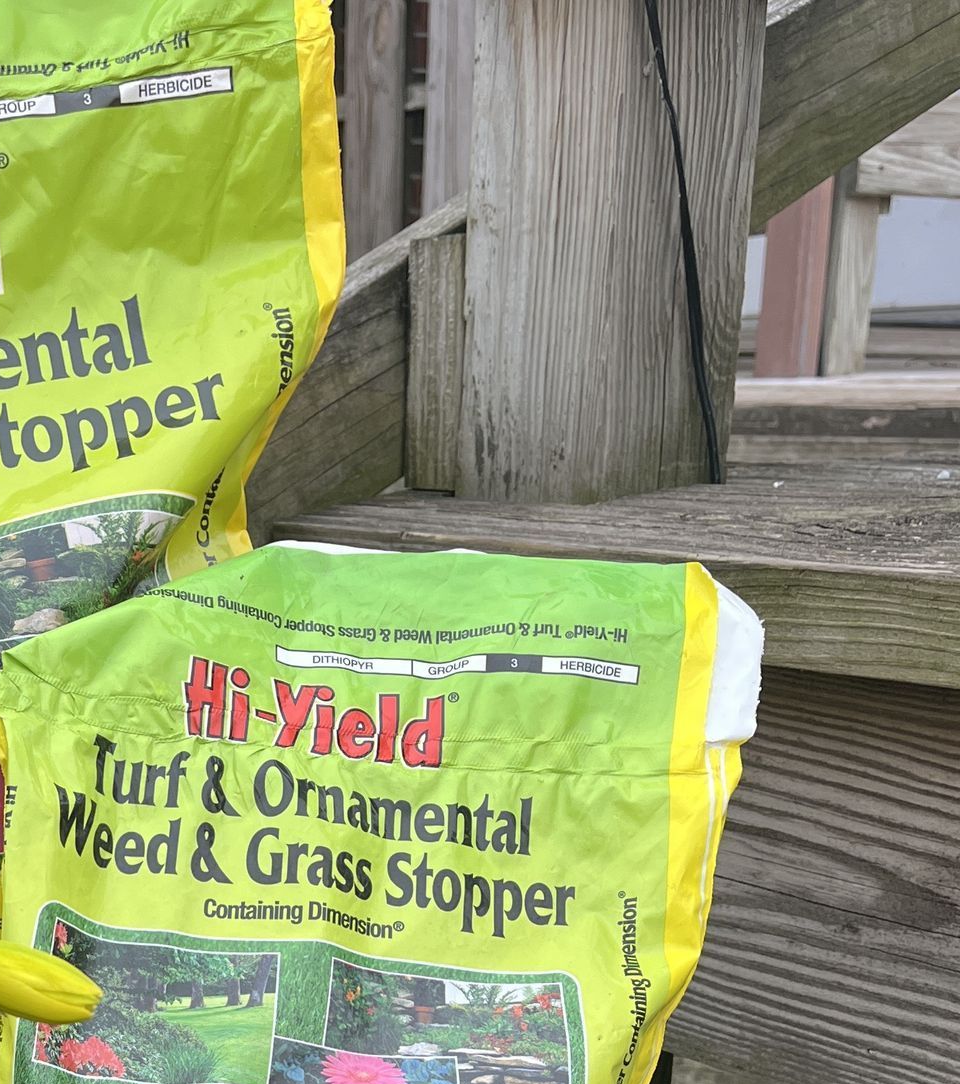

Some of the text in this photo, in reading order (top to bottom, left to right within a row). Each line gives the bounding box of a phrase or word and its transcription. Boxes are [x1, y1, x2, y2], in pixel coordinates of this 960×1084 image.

[83, 93, 93, 106] 3
[137, 74, 214, 98] HERBICIDE
[141, 588, 214, 609] Dimension
[218, 595, 282, 628] Containing
[284, 617, 336, 637] Stopper
[338, 626, 376, 642] Grass
[379, 628, 391, 642] &
[393, 628, 432, 645] Weed
[435, 622, 516, 645] Ornamental
[518, 622, 531, 636] &
[532, 622, 562, 638] Turf
[311, 654, 622, 678] DITHIOPYR GROUP 3 HERBICIDE
[93, 735, 533, 856] Turf & Ornamental
[53, 783, 182, 875] Weed
[190, 819, 233, 884] &
[244, 826, 374, 902] Grass
[383, 851, 576, 938] Stopper
[203, 898, 405, 940] Containing Dimension®
